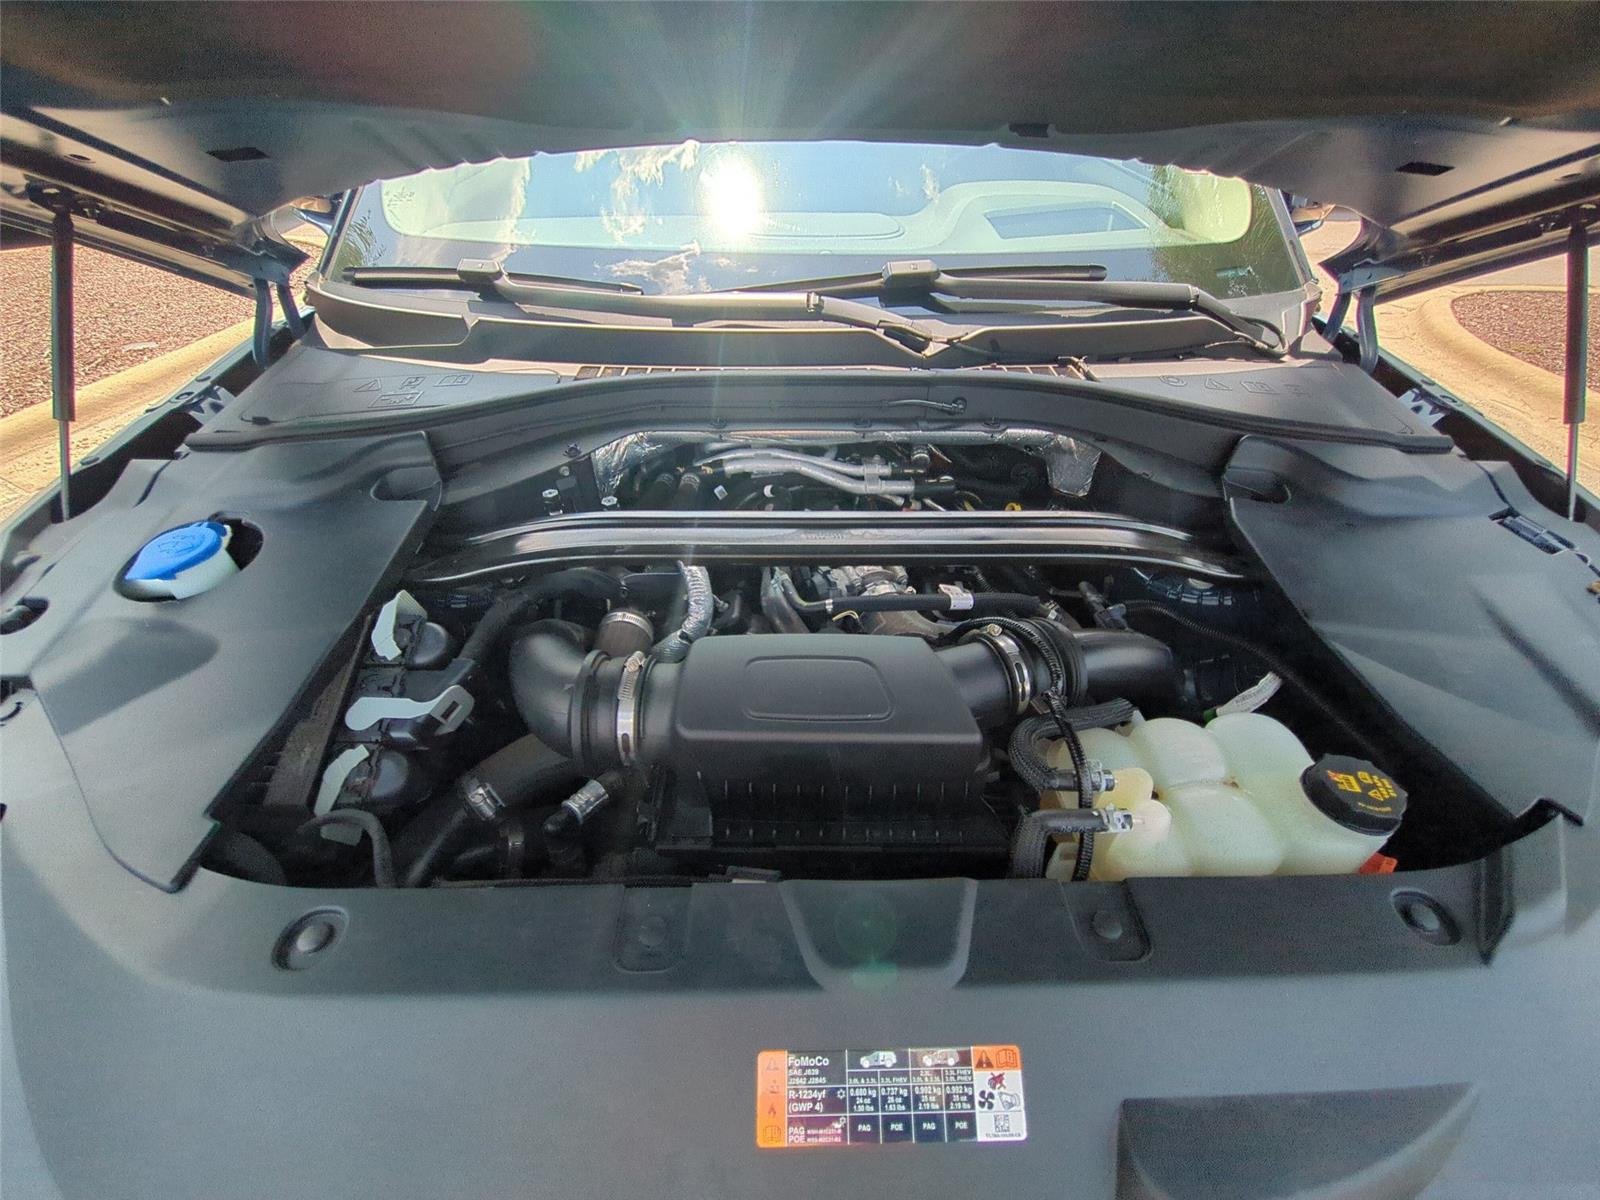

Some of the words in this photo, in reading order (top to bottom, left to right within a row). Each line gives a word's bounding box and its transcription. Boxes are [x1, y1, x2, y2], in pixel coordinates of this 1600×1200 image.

[788, 1055, 829, 1067] FoMoCo
[788, 1089, 826, 1100] R-1234yf
[868, 1087, 877, 1098] kg
[881, 1087, 897, 1095] 0.737
[899, 1087, 908, 1097] kg
[932, 1086, 941, 1096] kg
[964, 1085, 973, 1095] kg
[788, 1102, 813, 1113] (GWP
[814, 1101, 823, 1113] 4)
[858, 1124, 871, 1132] PAG
[890, 1123, 903, 1131] POE
[922, 1122, 936, 1130] PAG
[955, 1121, 969, 1129] POE
[788, 1127, 805, 1135] PAG
[788, 1135, 805, 1143] POE
